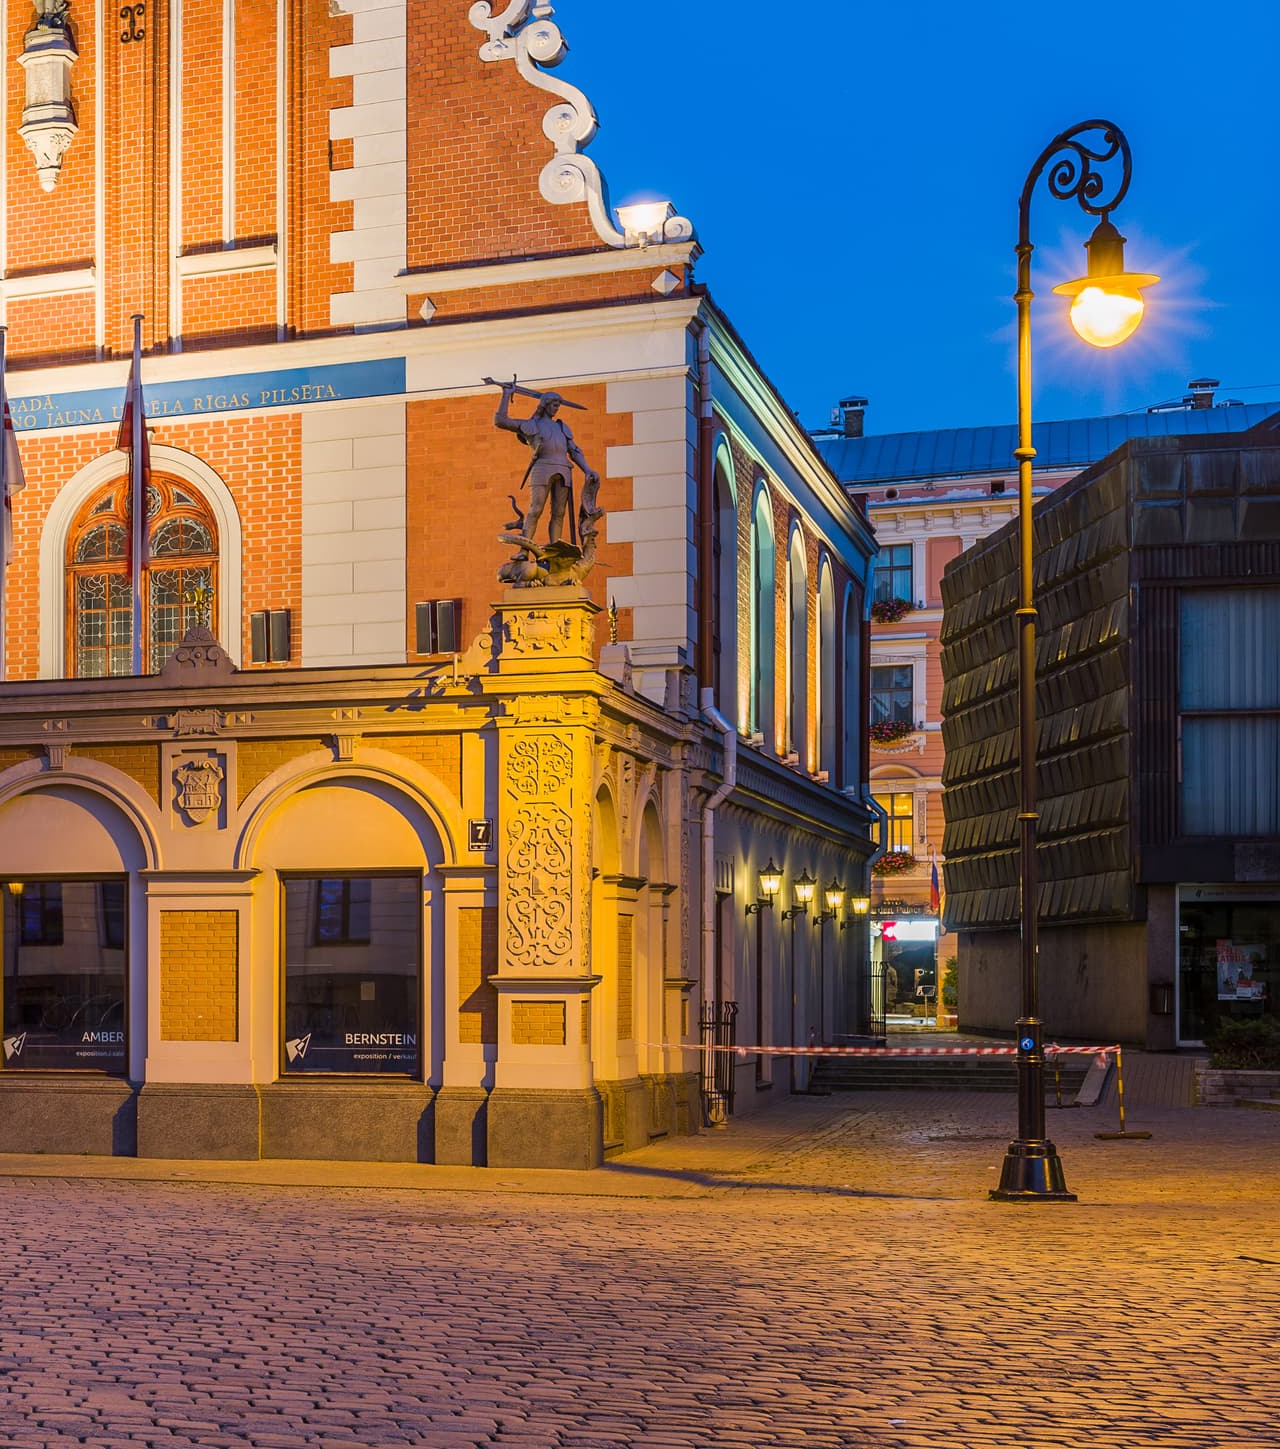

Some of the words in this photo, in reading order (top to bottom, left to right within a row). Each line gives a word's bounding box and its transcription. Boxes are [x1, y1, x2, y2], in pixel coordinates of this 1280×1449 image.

[47, 408, 103, 427] JAUNA
[112, 399, 184, 420] UCĒLA
[192, 393, 249, 410] RĪGAS
[476, 826, 486, 840] 7
[81, 1032, 124, 1042] AMBER
[345, 1033, 417, 1045] BERNSTEIN
